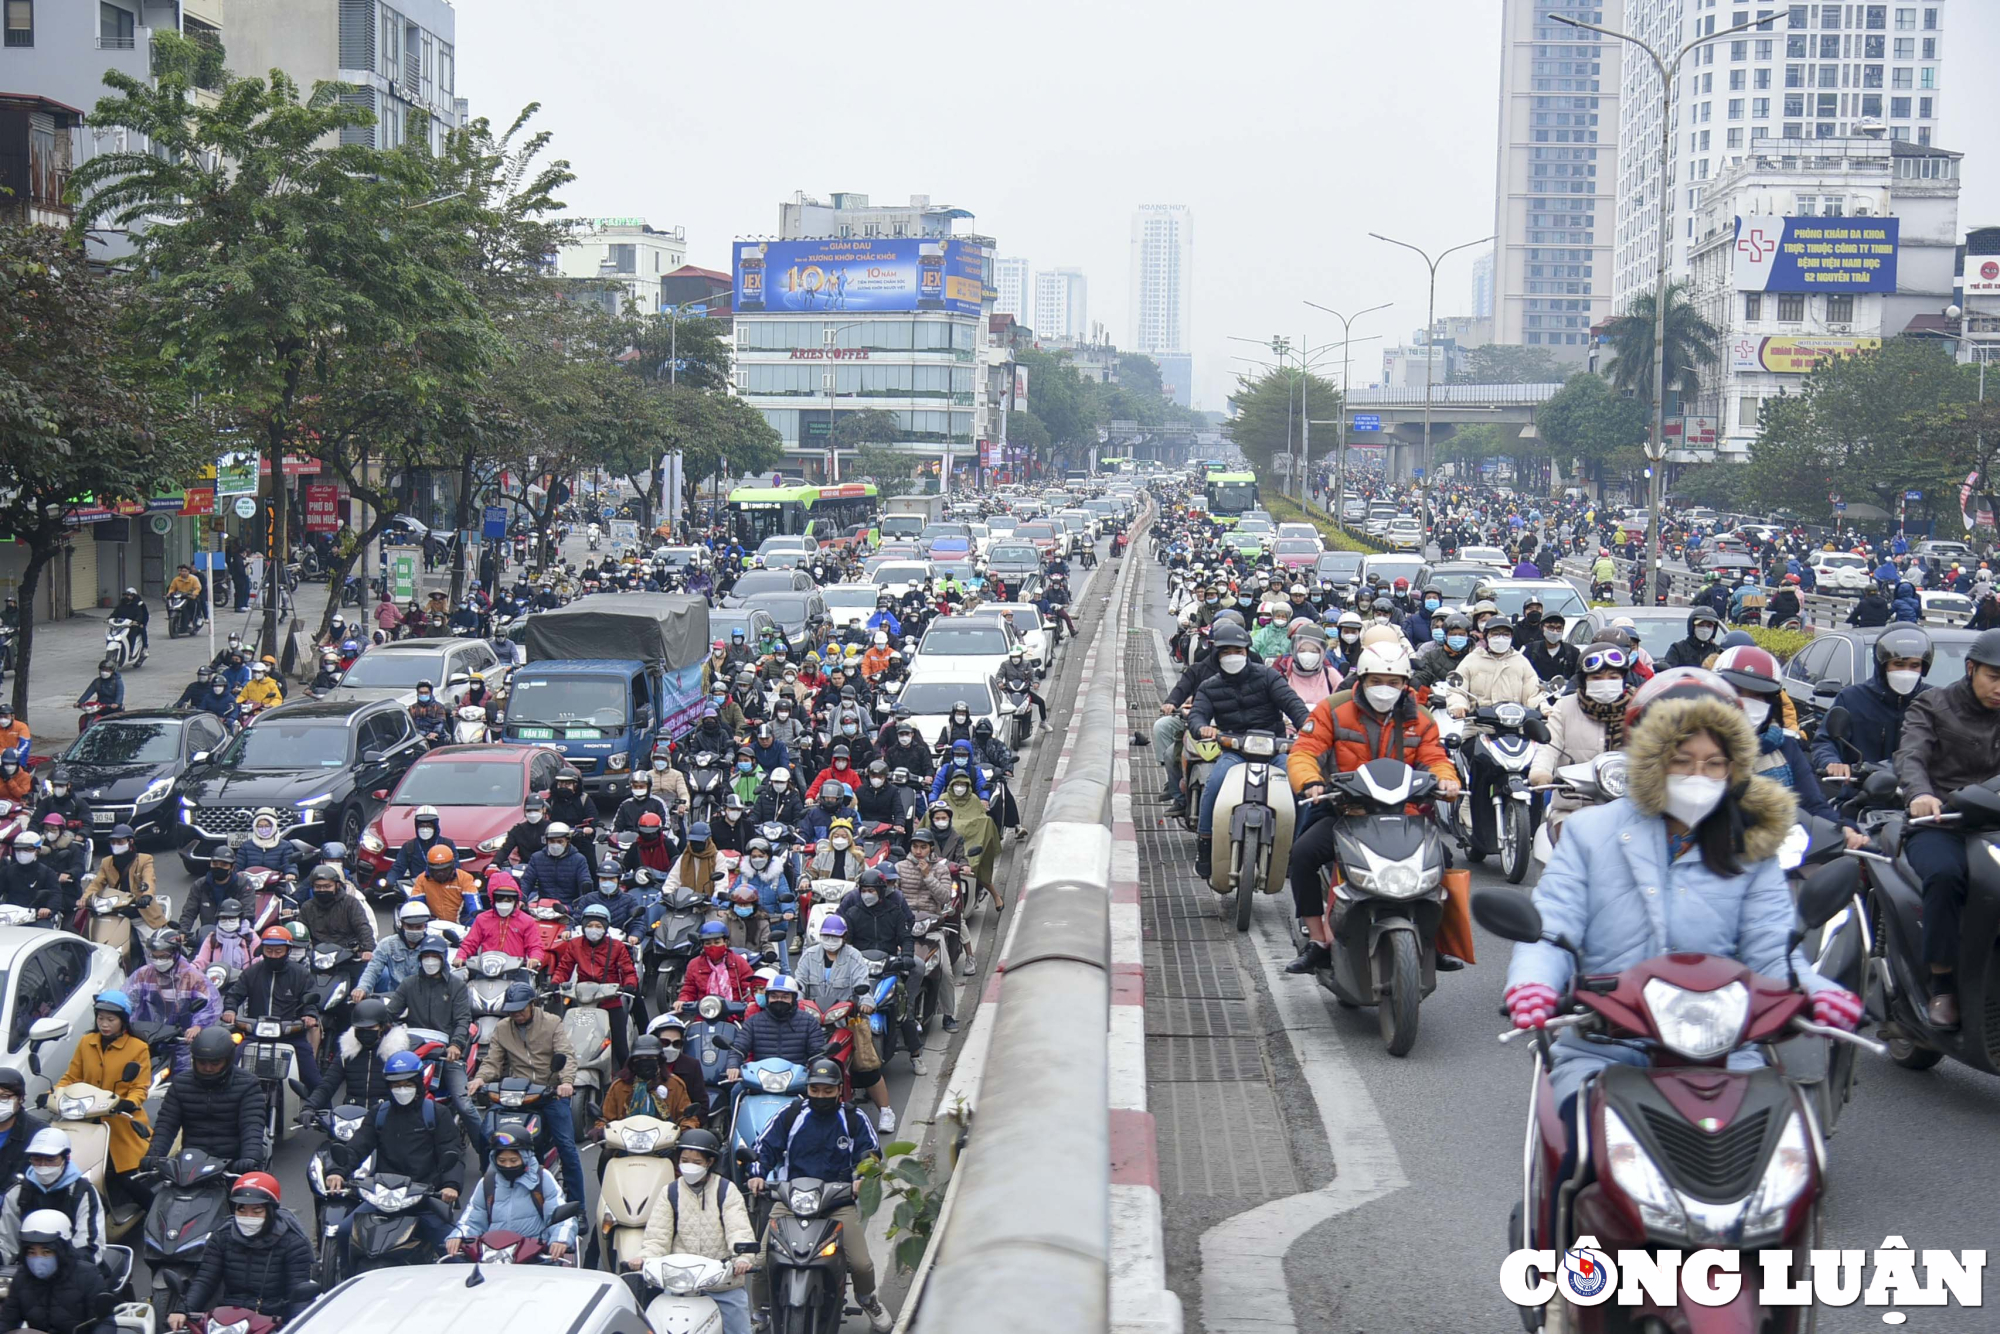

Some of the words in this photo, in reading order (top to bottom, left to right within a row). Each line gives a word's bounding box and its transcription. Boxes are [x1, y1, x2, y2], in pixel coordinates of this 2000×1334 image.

[1794, 228, 1822, 238] PHÒNG
[1824, 228, 1848, 239] KHÁM
[1850, 230, 1861, 239] ĐA
[1863, 230, 1886, 239] KHOA
[830, 241, 851, 250] GIẢM
[1784, 243, 1805, 254] TRỰC
[1806, 242, 1833, 255] THUỘC
[1834, 243, 1857, 253] CÔNG
[1859, 244, 1869, 253] TY
[1871, 244, 1893, 254] TNHH
[835, 253, 854, 261] KHỚP
[856, 253, 875, 261] CHẮC
[1797, 256, 1820, 269] BỆNH
[1822, 257, 1840, 269] VIỆN
[1842, 259, 1861, 268] NAM
[1863, 259, 1880, 270] HỌC
[788, 265, 825, 292] 10
[866, 267, 880, 278] 10
[1804, 273, 1815, 282] 52
[1817, 270, 1850, 282] NGUYỄN
[1851, 271, 1870, 282] TRÃI
[743, 274, 762, 288] JEX
[922, 272, 942, 286] JEX
[789, 348, 824, 359] ARIES
[826, 348, 869, 360] COFFEE
[309, 498, 323, 511] PHỞ
[324, 500, 333, 511] BÒ
[307, 513, 321, 524] BÚN
[323, 512, 336, 524] HUẾ
[524, 728, 538, 739] VẬN
[538, 728, 549, 738] TẢI
